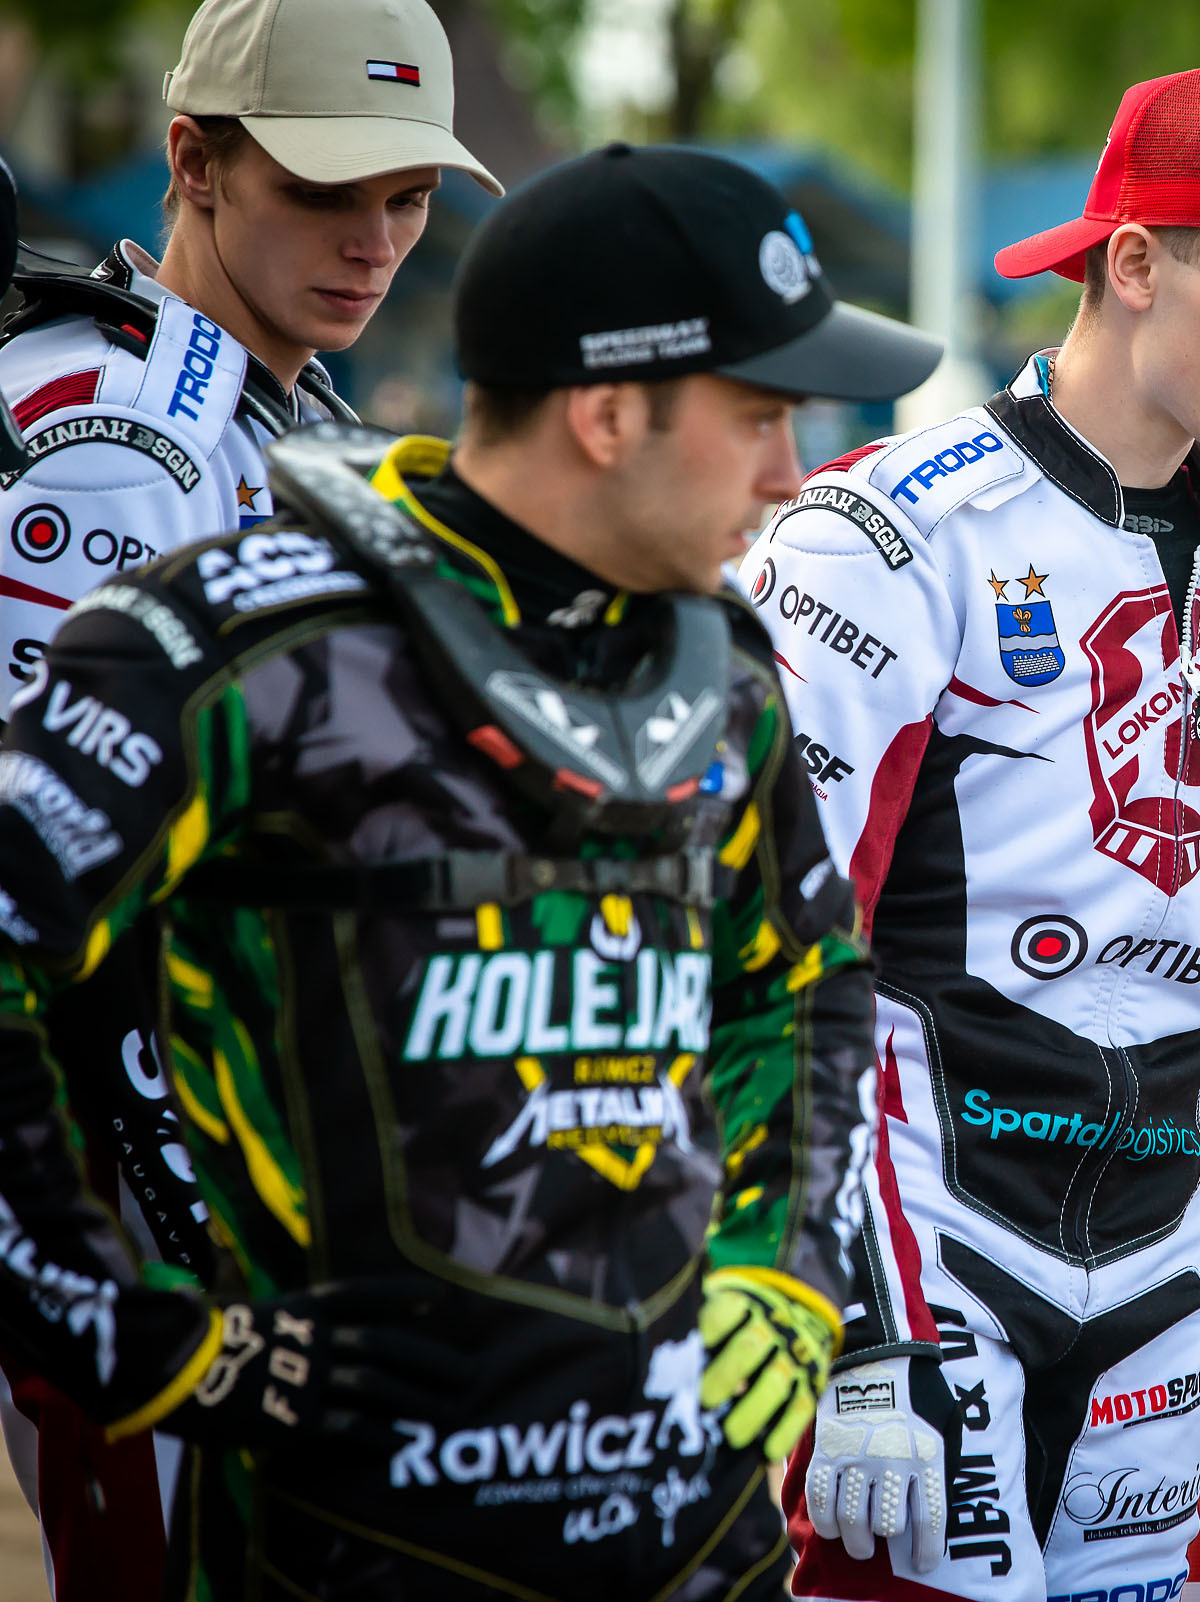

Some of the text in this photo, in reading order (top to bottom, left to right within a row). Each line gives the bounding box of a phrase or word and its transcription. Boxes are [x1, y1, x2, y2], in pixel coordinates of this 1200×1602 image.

[166, 313, 222, 422] TRODO
[891, 431, 1004, 505] TRODO
[779, 585, 898, 680] OPTIBET
[42, 681, 163, 788] VIRS
[403, 948, 713, 1061] KOLEJAR
[389, 1400, 656, 1488] Rawicz
